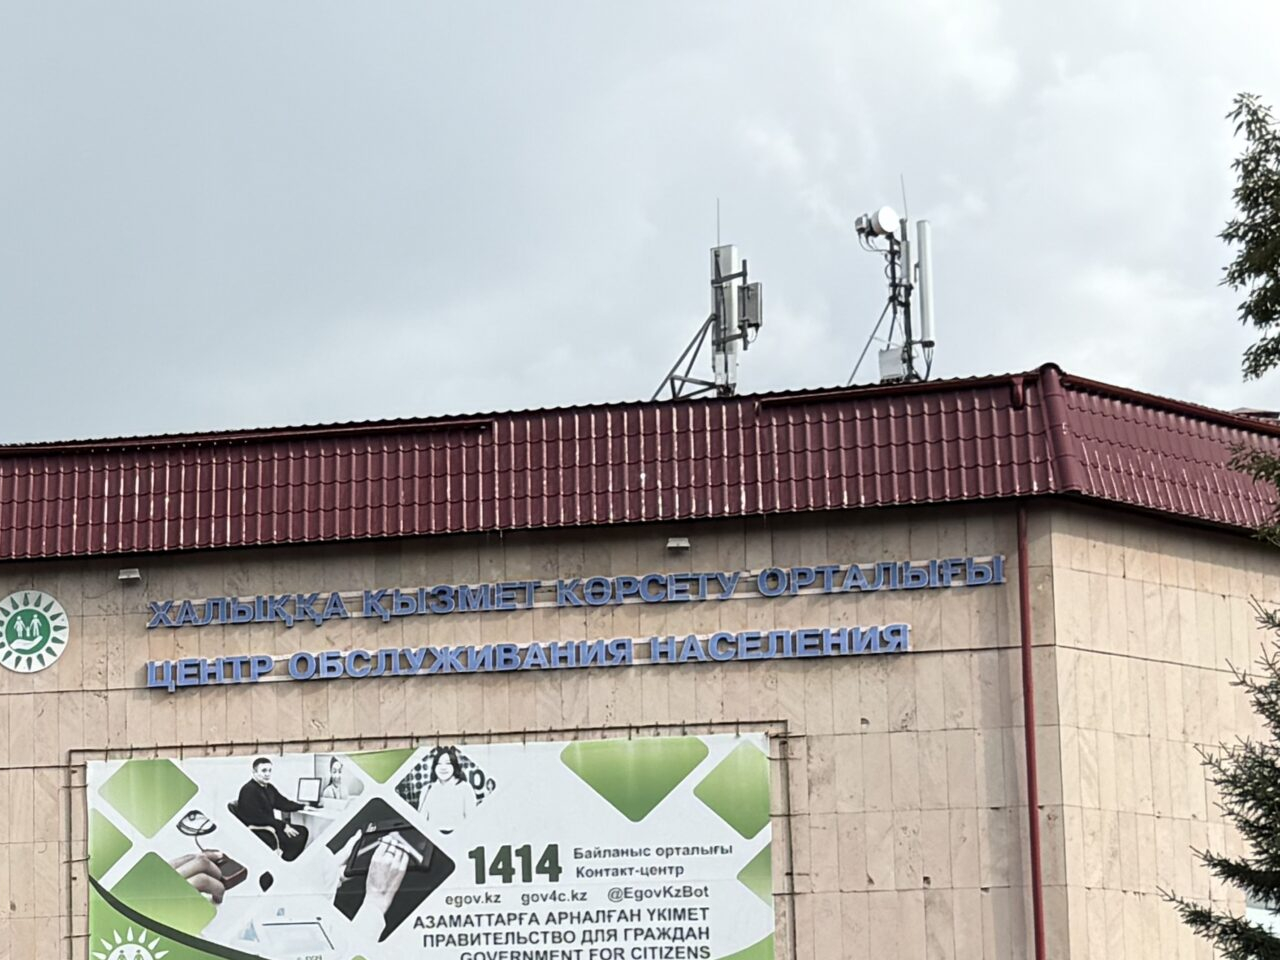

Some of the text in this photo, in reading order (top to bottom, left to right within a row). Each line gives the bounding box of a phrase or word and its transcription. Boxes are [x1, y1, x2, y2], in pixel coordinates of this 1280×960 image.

[148, 591, 350, 628] ХАЛЫҚҚА
[363, 581, 542, 622] ҚЫЗМЕТ
[757, 555, 1003, 599] ОРТАЛЫҒЫ
[147, 623, 911, 693] ЦЕНТР ОБСЛУЖИВАНИЯ НАСЕЛЕНИЯ
[574, 845, 733, 859] Байланыс орталығы
[468, 844, 562, 884] 1414
[576, 866, 684, 878] Контакт-центр
[445, 885, 709, 908] egov.kz gov4c.kz @EgovKzBot
[413, 912, 540, 929] АЗАМАТТАРҒА
[545, 908, 642, 925] АРНАЛҒАН
[423, 926, 710, 948] ПРАВИТЕЛЬСТВО ДЛЯ ГРАЖДАН
[631, 945, 711, 960] CITIZENS
